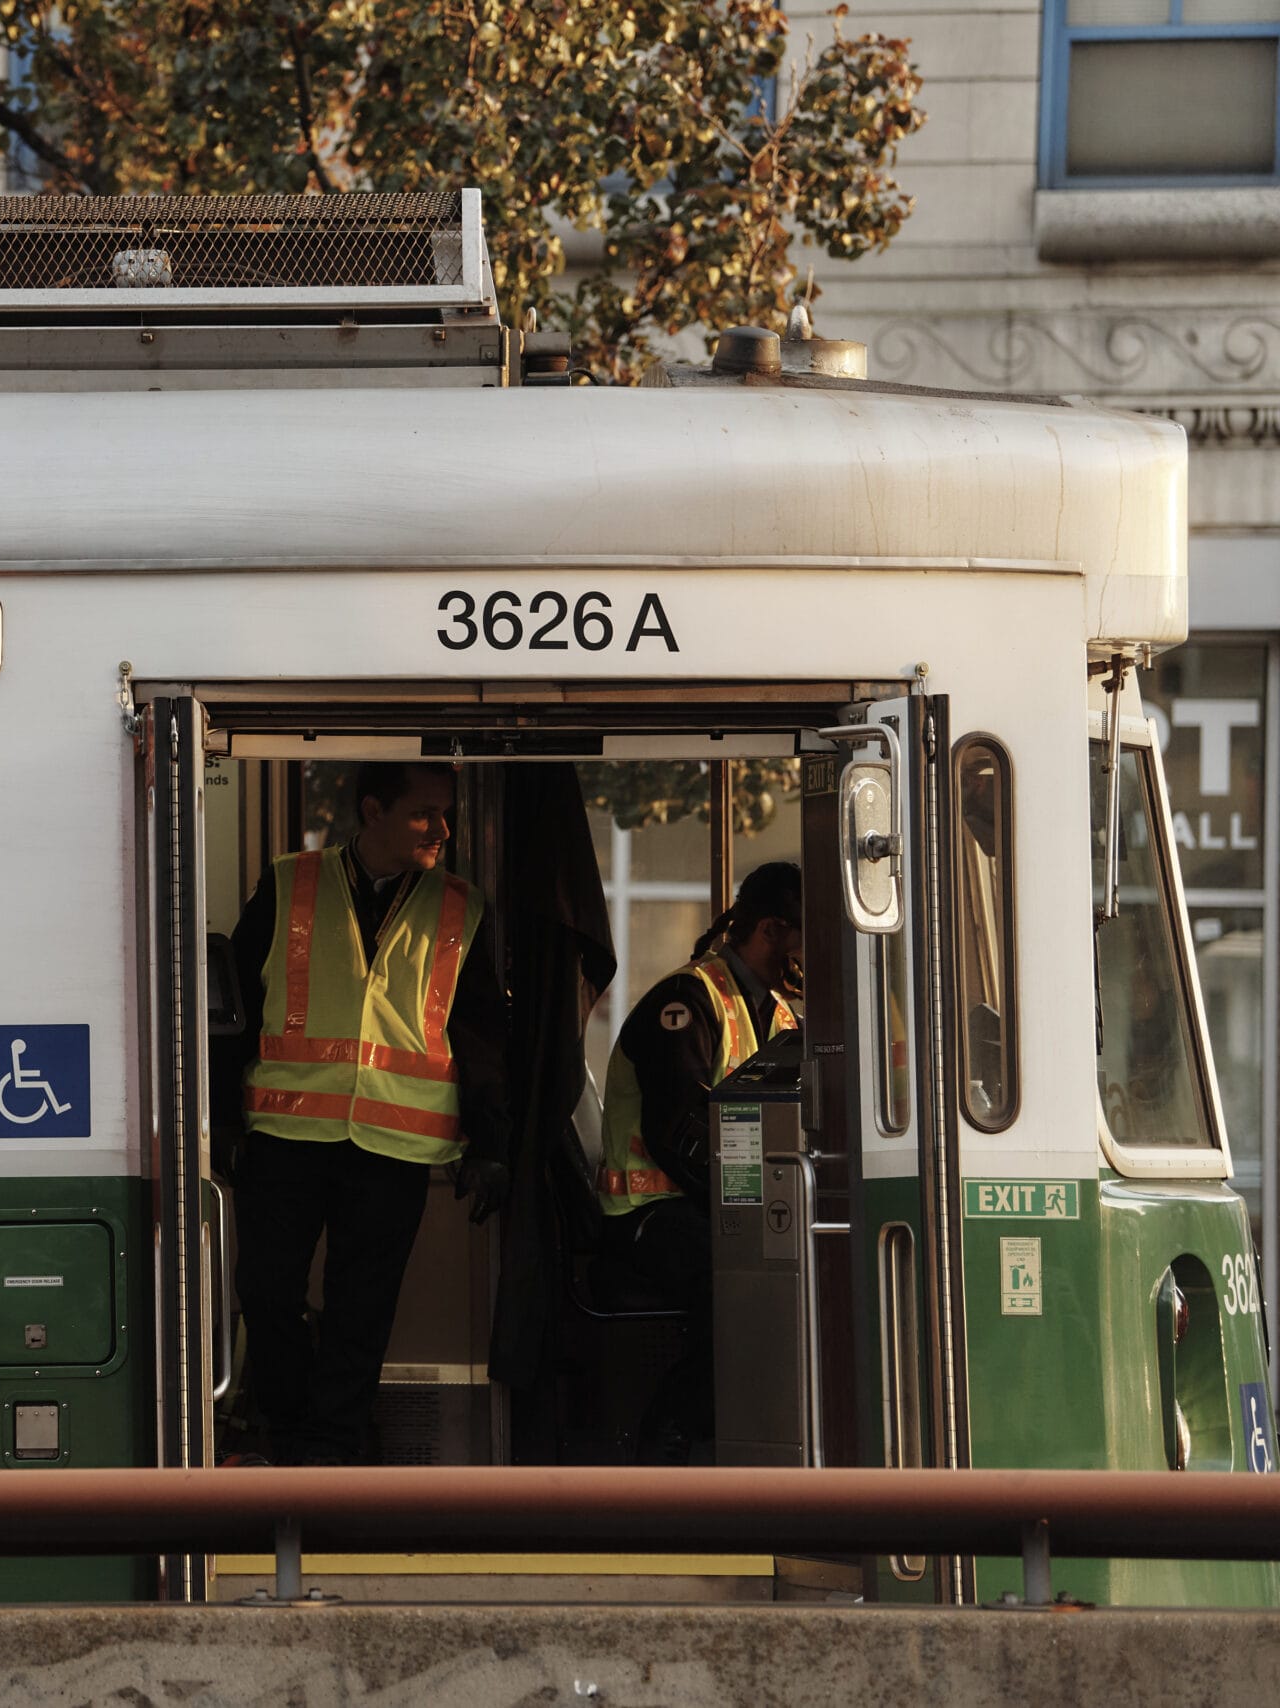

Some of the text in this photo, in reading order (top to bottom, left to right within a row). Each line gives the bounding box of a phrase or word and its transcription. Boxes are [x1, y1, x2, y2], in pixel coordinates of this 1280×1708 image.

[437, 590, 680, 653] 3626 A
[664, 1009, 686, 1026] T
[978, 1185, 1036, 1212] EXIT
